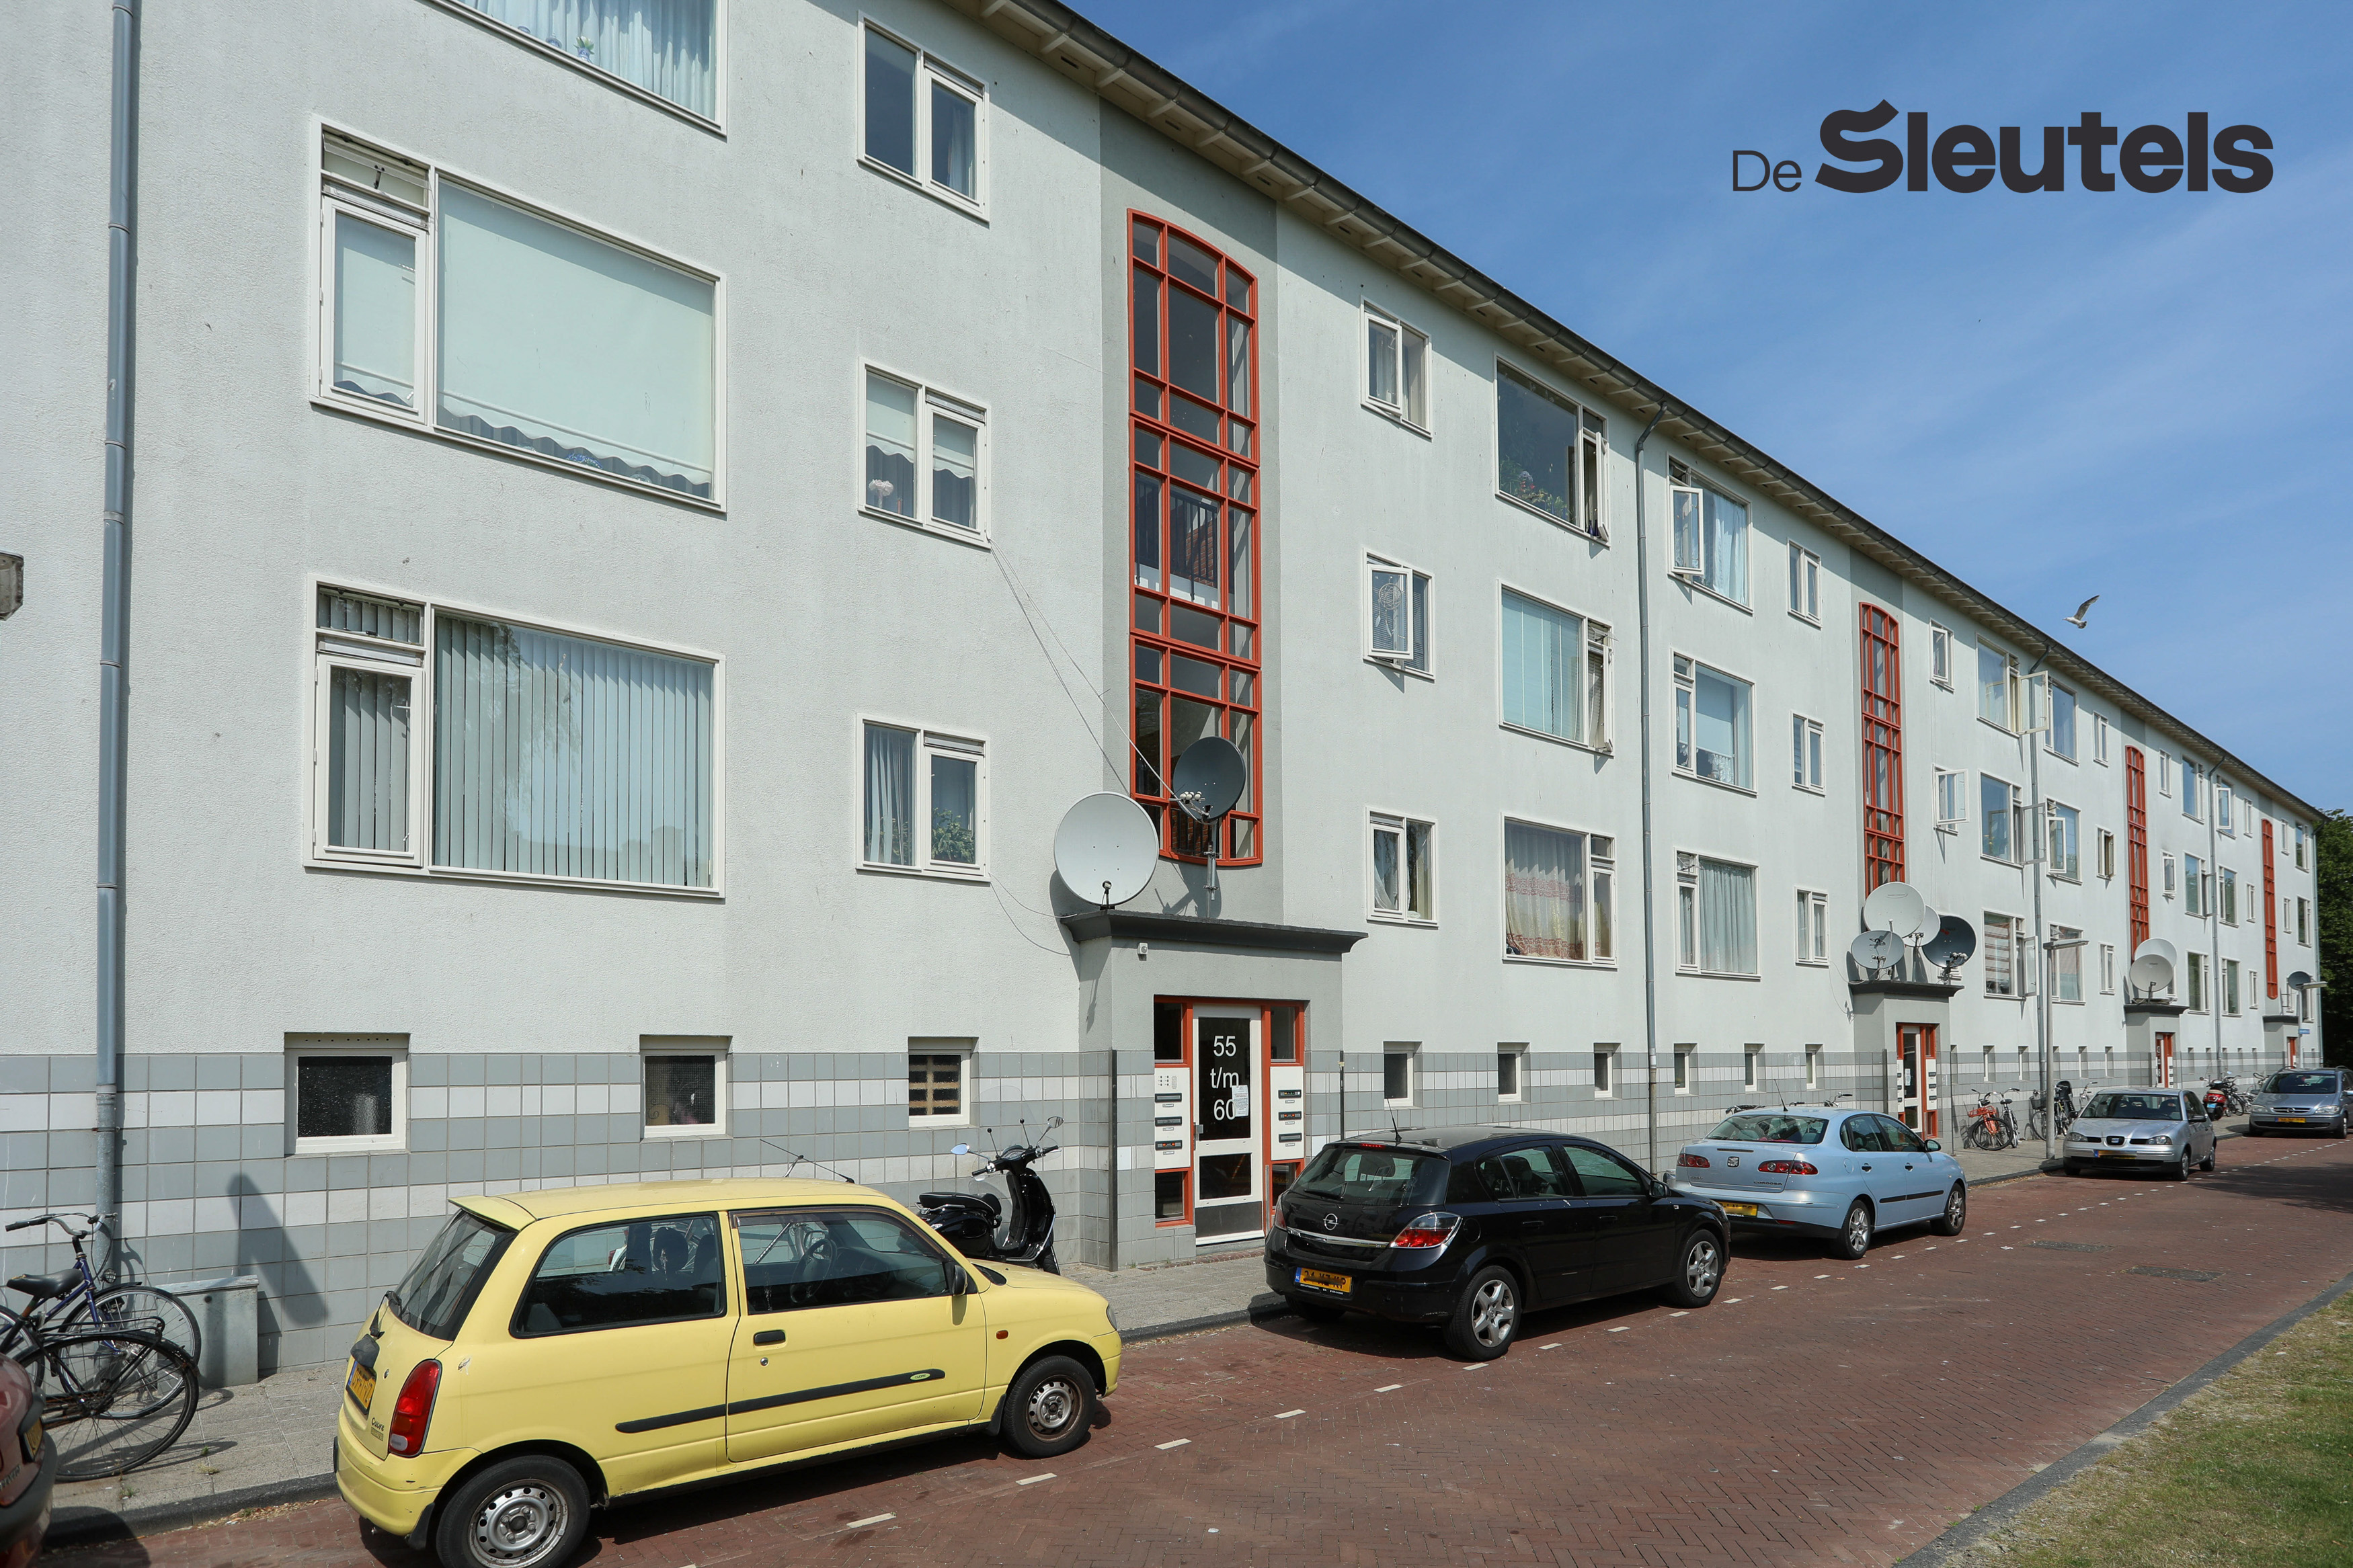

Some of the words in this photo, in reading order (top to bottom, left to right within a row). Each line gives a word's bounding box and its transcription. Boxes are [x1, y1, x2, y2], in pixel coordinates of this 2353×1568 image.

[1213, 1036, 1236, 1056] 55
[1210, 1067, 1239, 1088] t/m
[1213, 1099, 1236, 1120] 60
[371, 1417, 385, 1432] Cuore
